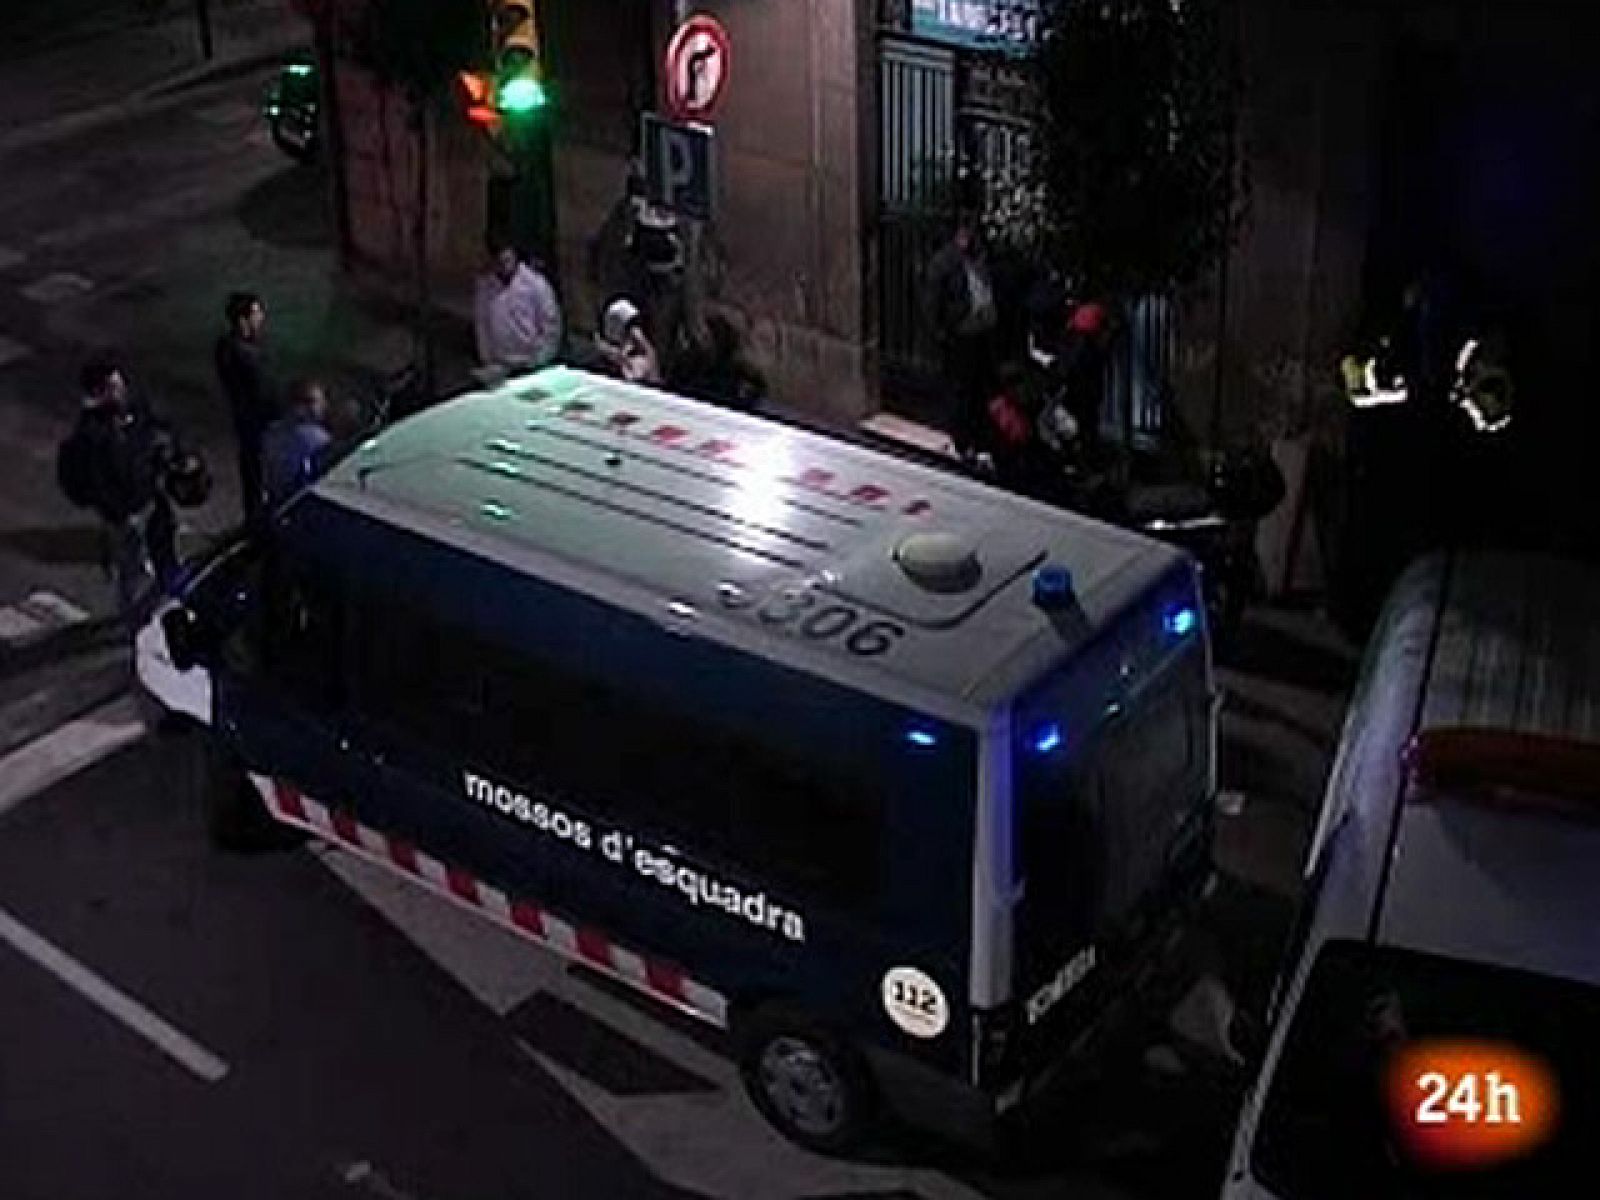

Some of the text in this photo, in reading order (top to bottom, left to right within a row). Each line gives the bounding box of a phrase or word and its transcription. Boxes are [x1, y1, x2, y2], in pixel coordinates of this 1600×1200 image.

[660, 127, 692, 205] P
[463, 769, 806, 943] mossos d'esquadra
[893, 979, 937, 1016] 112
